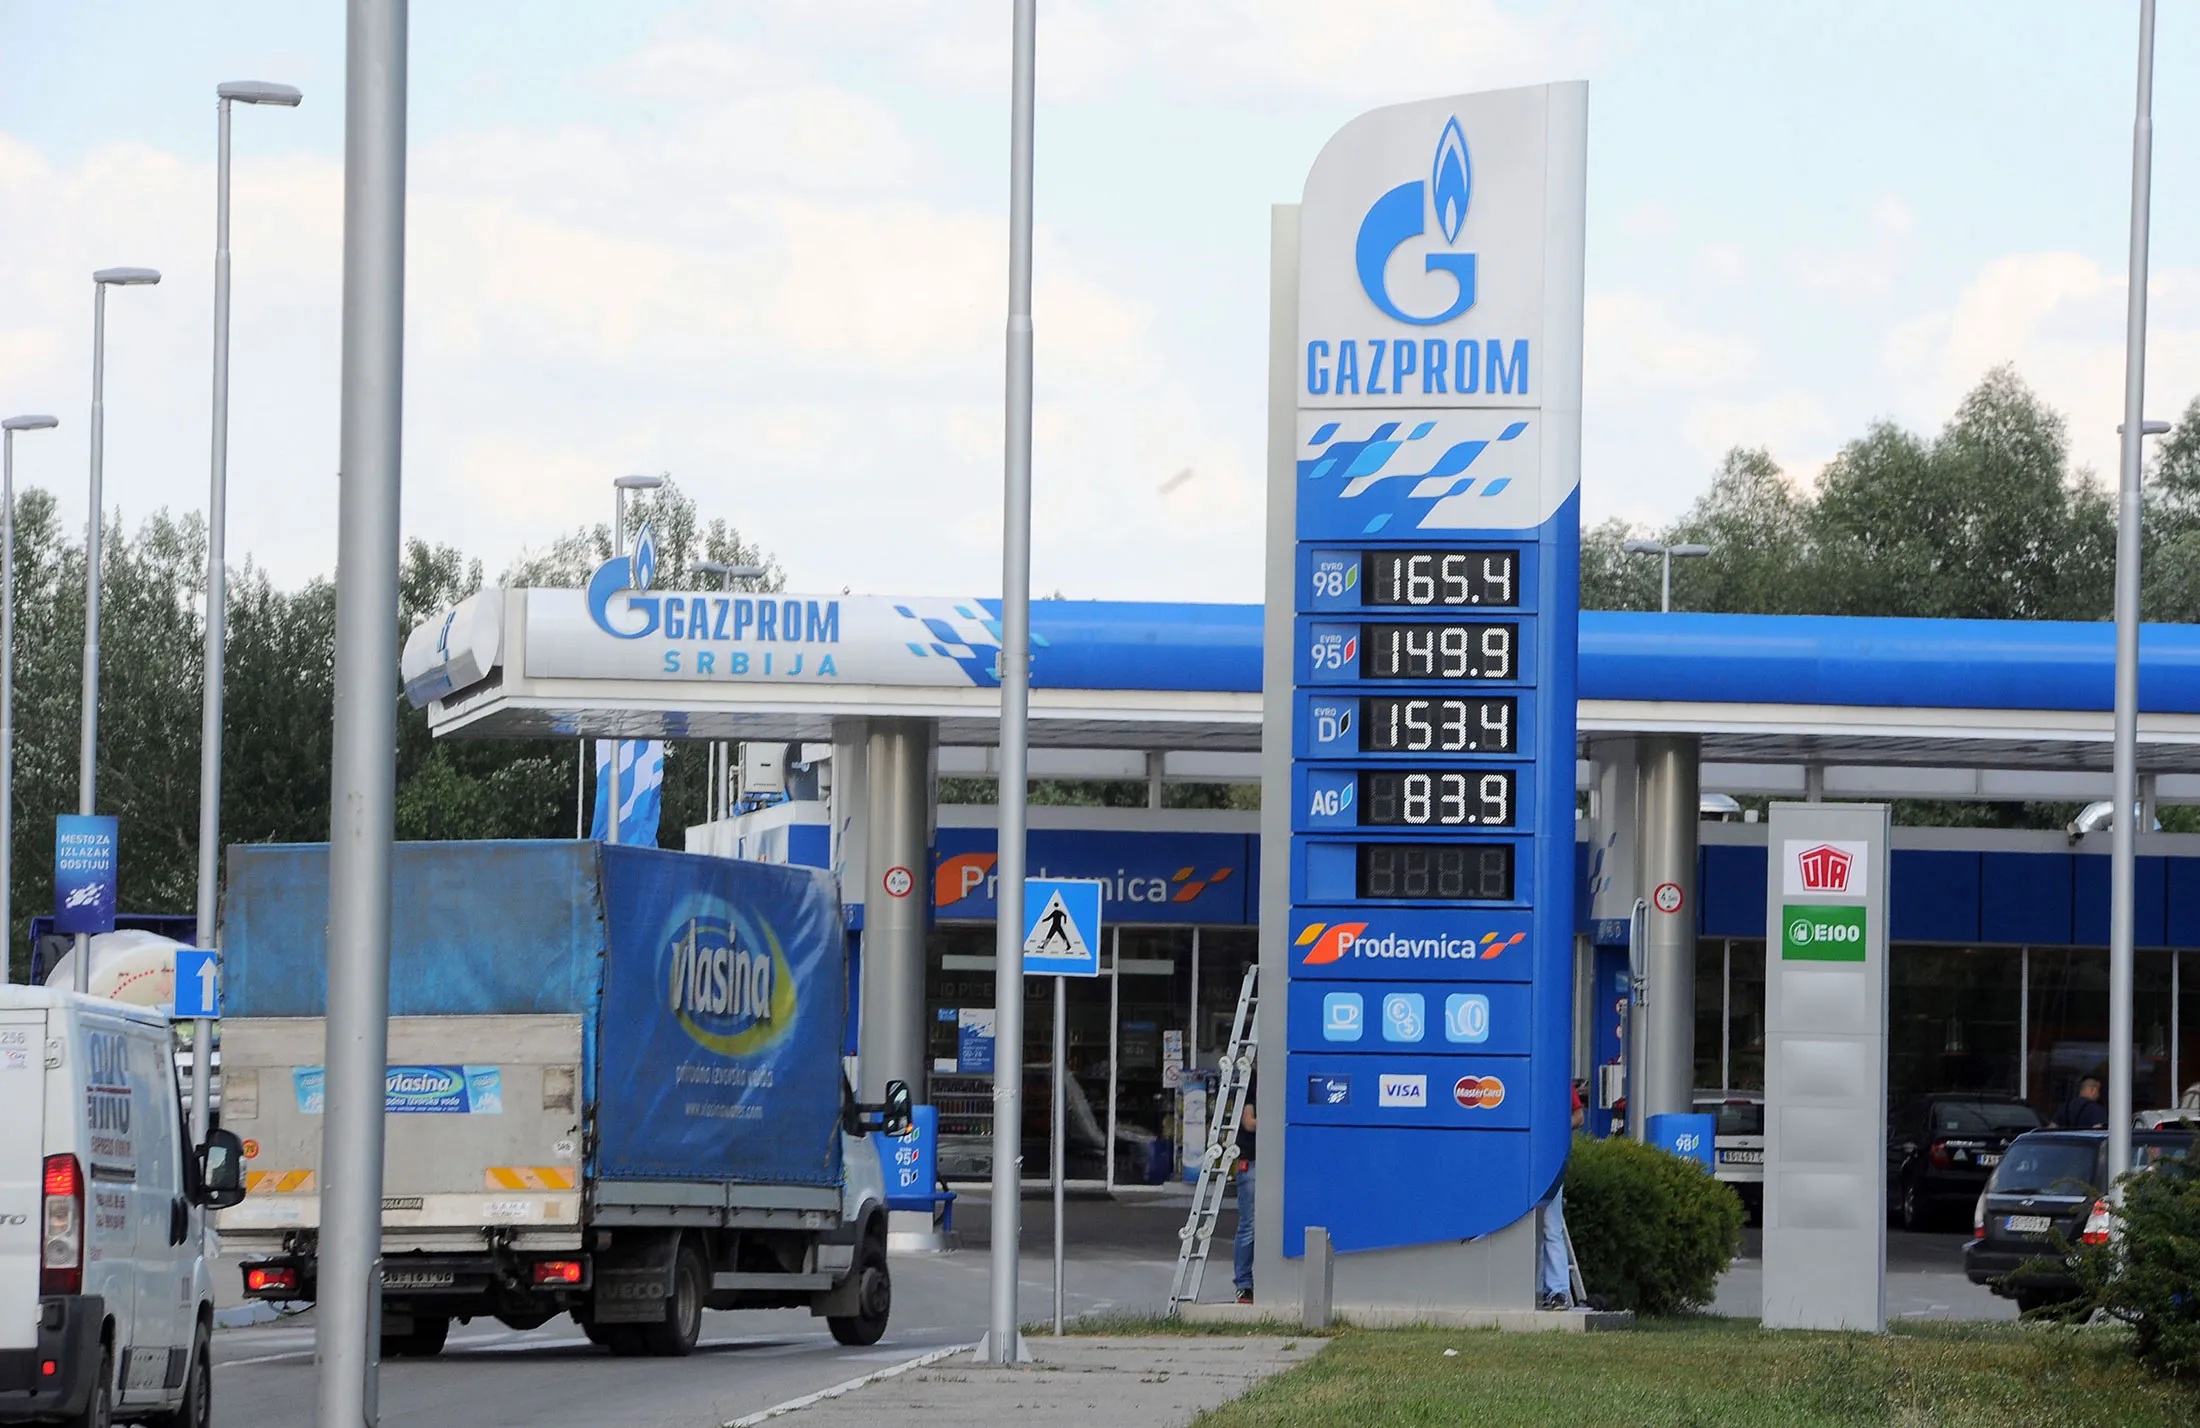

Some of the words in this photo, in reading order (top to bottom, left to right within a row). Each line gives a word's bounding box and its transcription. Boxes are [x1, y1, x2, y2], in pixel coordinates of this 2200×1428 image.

[1307, 338, 1530, 395] GAZPROM
[1320, 562, 1343, 571] EVRO
[1393, 554, 1511, 605] 165.4
[1312, 571, 1343, 597] 98
[665, 597, 839, 643] GAZPROM
[1319, 634, 1342, 644] EVRO
[663, 650, 838, 677] SRBIJA
[1311, 644, 1342, 670] 95
[1391, 627, 1510, 678] 149.9
[1314, 707, 1337, 717] EVRO
[1390, 700, 1509, 750] 153.4
[1318, 717, 1337, 743] D
[1310, 790, 1339, 816] AG
[1402, 773, 1508, 825] 83.9
[60, 847, 110, 857] IZLAZAK
[61, 834, 96, 845] MESTO
[96, 834, 110, 845] ZA
[1801, 847, 1849, 888] UTA
[961, 866, 1168, 903] Prnica
[1337, 932, 1477, 960] Prodavnica
[1814, 924, 1860, 943] E100
[672, 916, 771, 1020] vlasina
[385, 1073, 452, 1092] vlasina
[1385, 1083, 1421, 1098] VISA
[1455, 1085, 1503, 1099] MasterCard
[895, 1150, 912, 1166] 95
[1675, 1138, 1692, 1153] 98
[901, 1172, 911, 1188] D
